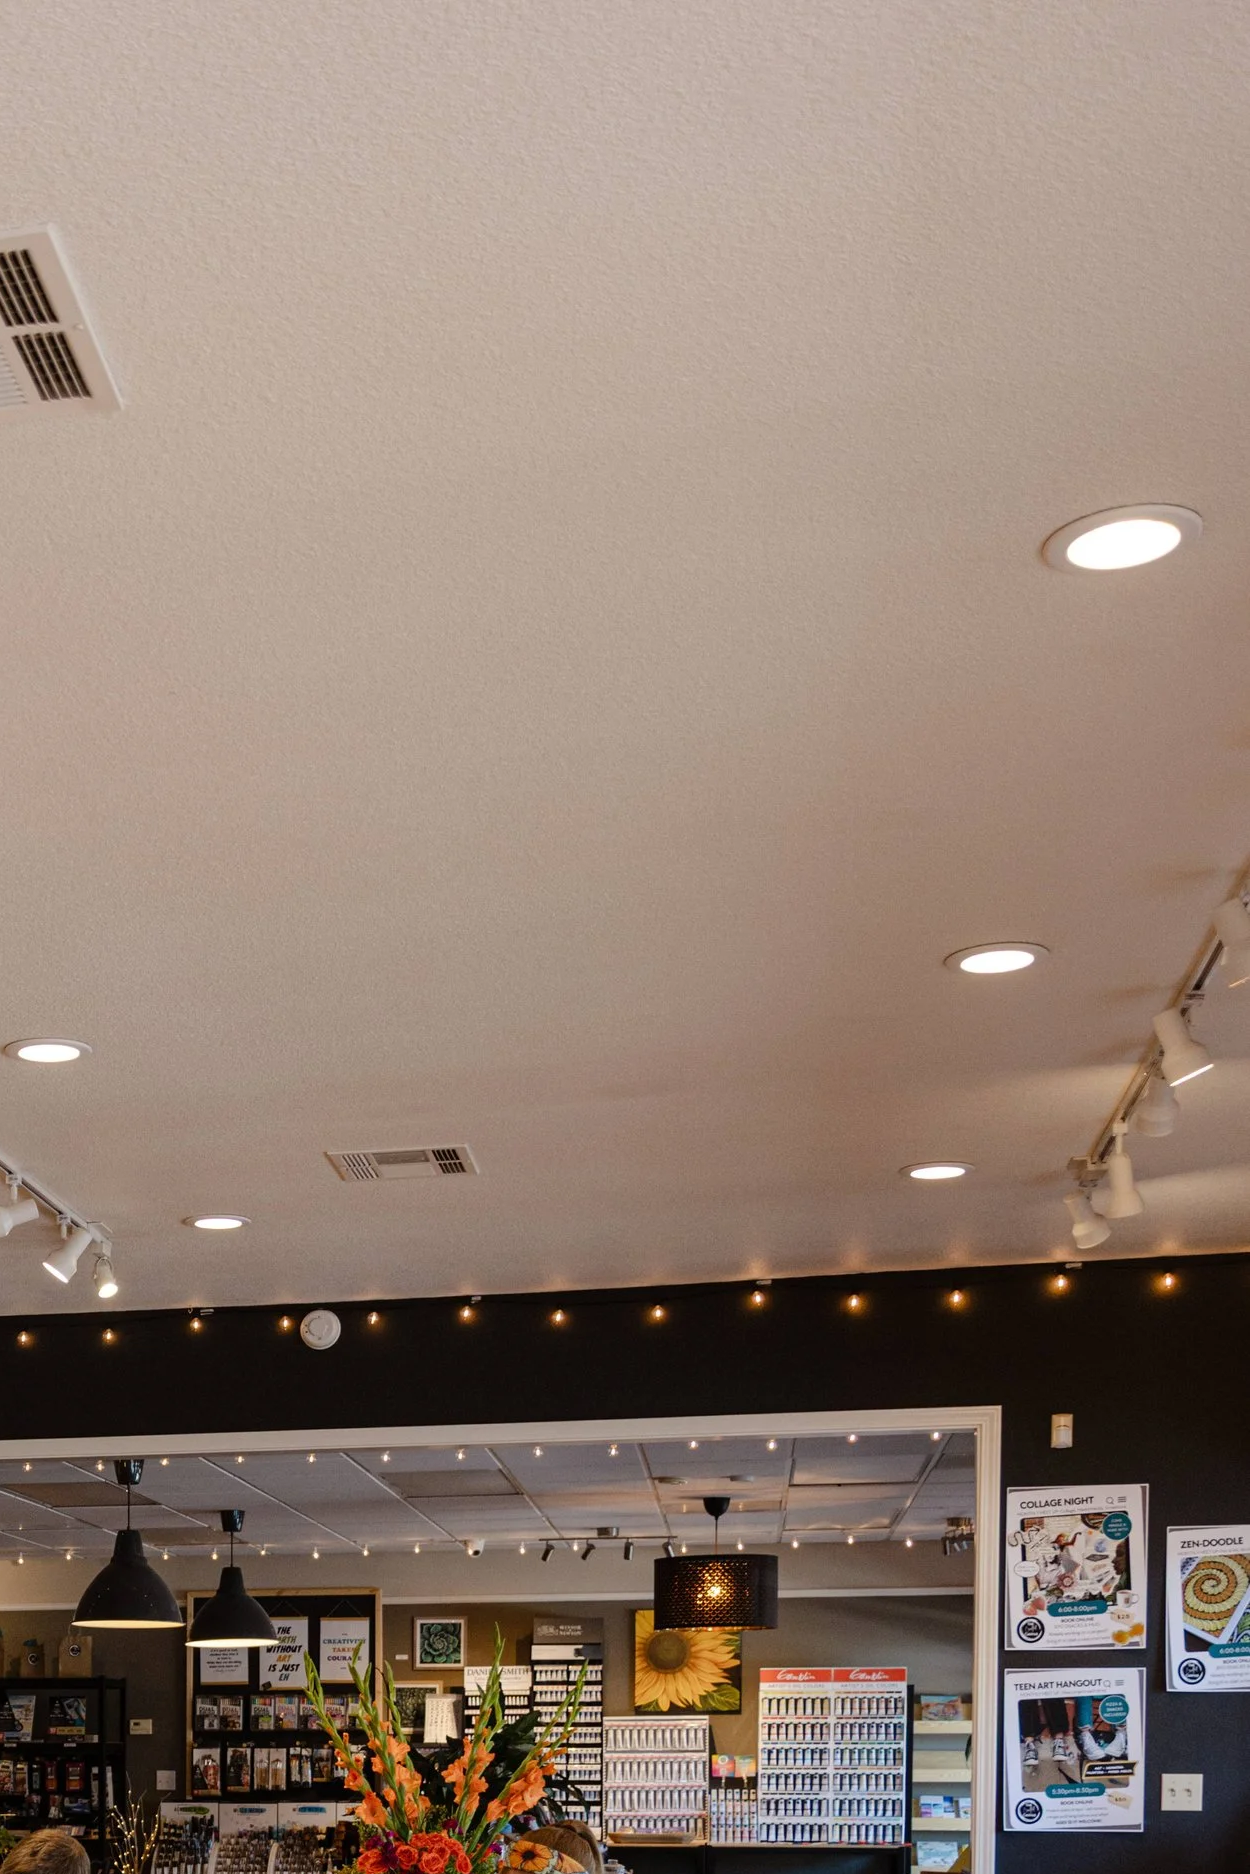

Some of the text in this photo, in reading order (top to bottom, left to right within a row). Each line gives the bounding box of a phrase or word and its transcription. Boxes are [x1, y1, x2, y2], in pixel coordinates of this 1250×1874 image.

[1019, 1498, 1062, 1510] COLLAGE
[1063, 1496, 1094, 1506] NIGHT
[1180, 1536, 1244, 1549] ZEN-DOODLE
[1058, 1606, 1098, 1614] 6:00-8:00pm
[277, 1626, 292, 1635] THE
[276, 1635, 297, 1644] ARTH
[266, 1645, 303, 1654] WITHOUT
[276, 1654, 293, 1663] ART
[268, 1664, 300, 1672] IS JUST
[502, 1667, 531, 1677] SMITH
[278, 1673, 290, 1681] EH
[1014, 1679, 1103, 1691] TEEN ART HANGOUT
